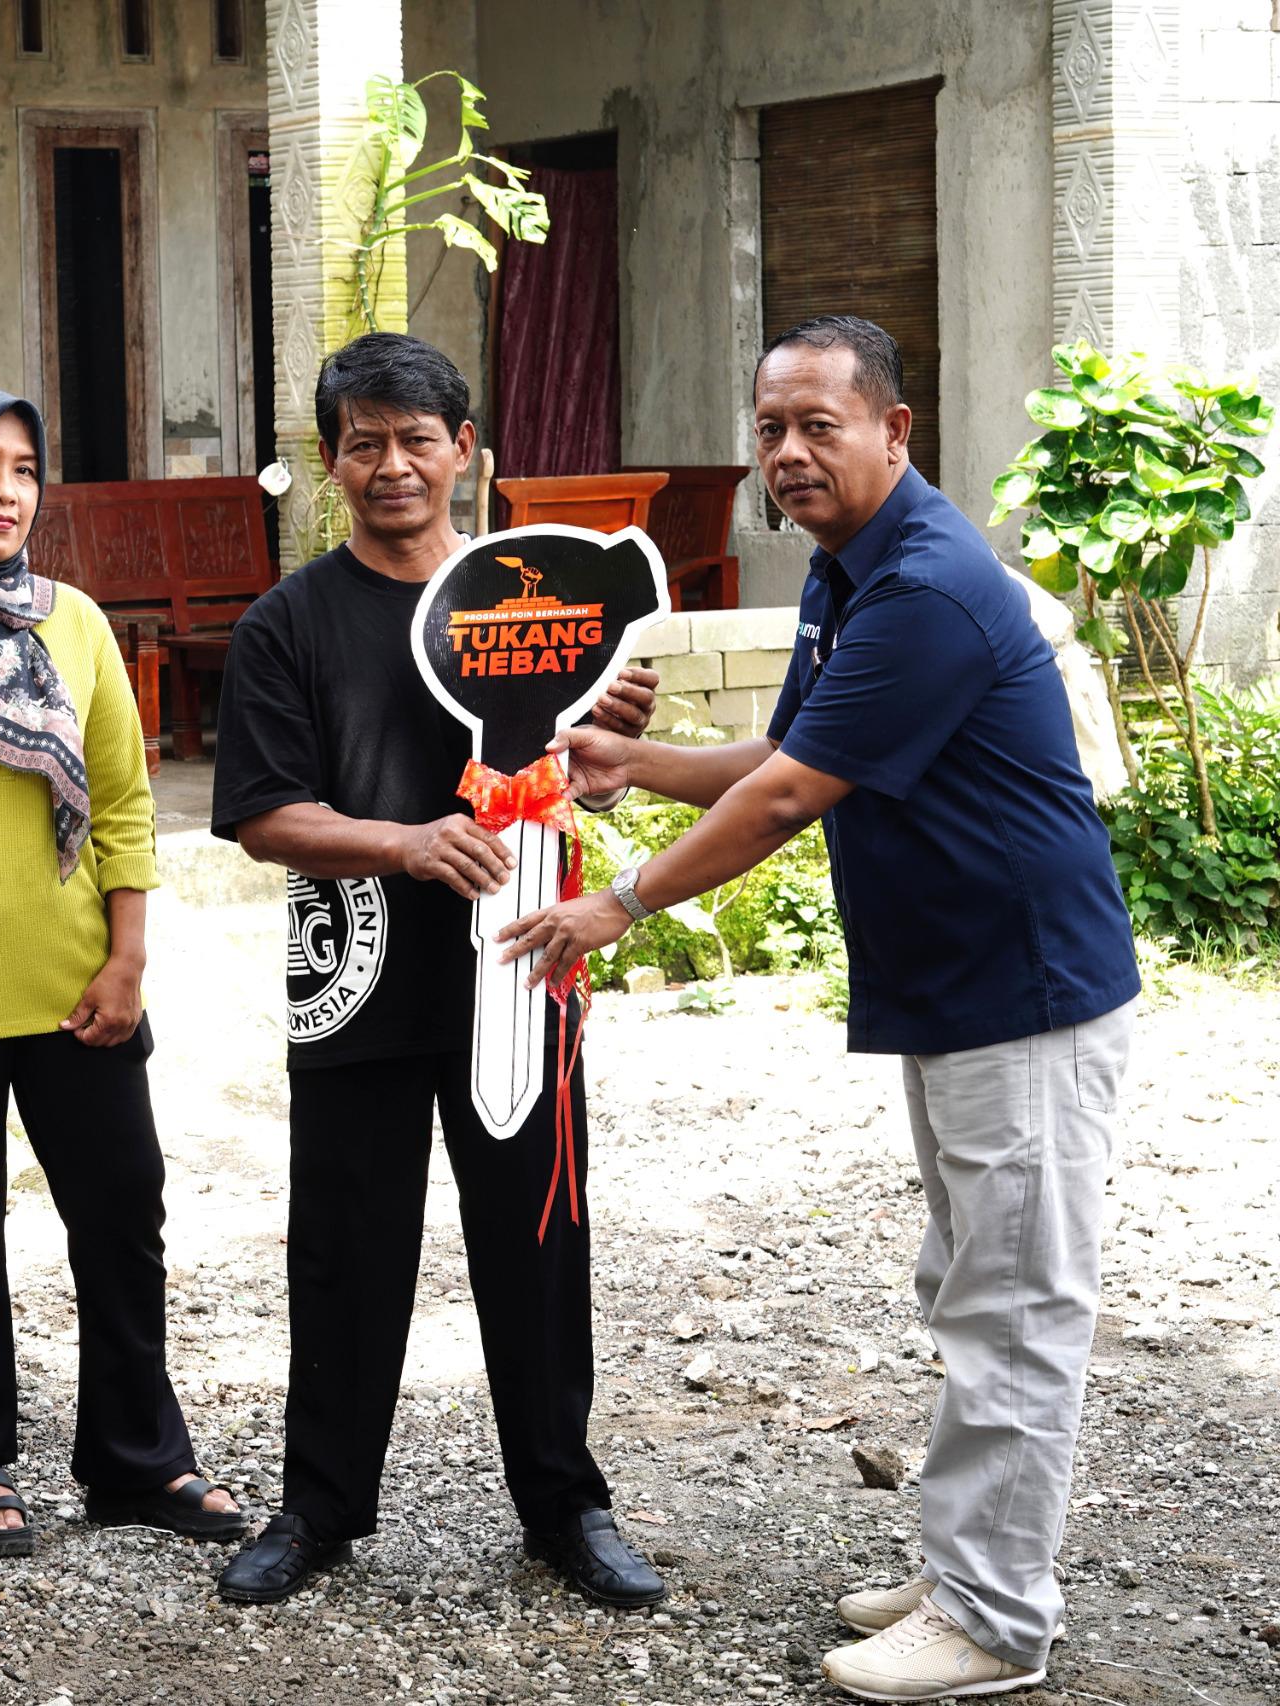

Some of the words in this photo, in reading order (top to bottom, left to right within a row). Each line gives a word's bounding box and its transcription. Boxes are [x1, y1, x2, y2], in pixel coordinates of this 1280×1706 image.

[464, 612, 509, 621] PROGRAM
[511, 610, 533, 619] POIN
[535, 608, 589, 618] BERHADIAH
[447, 620, 602, 652] TUKANG
[461, 648, 583, 677] HEBAT
